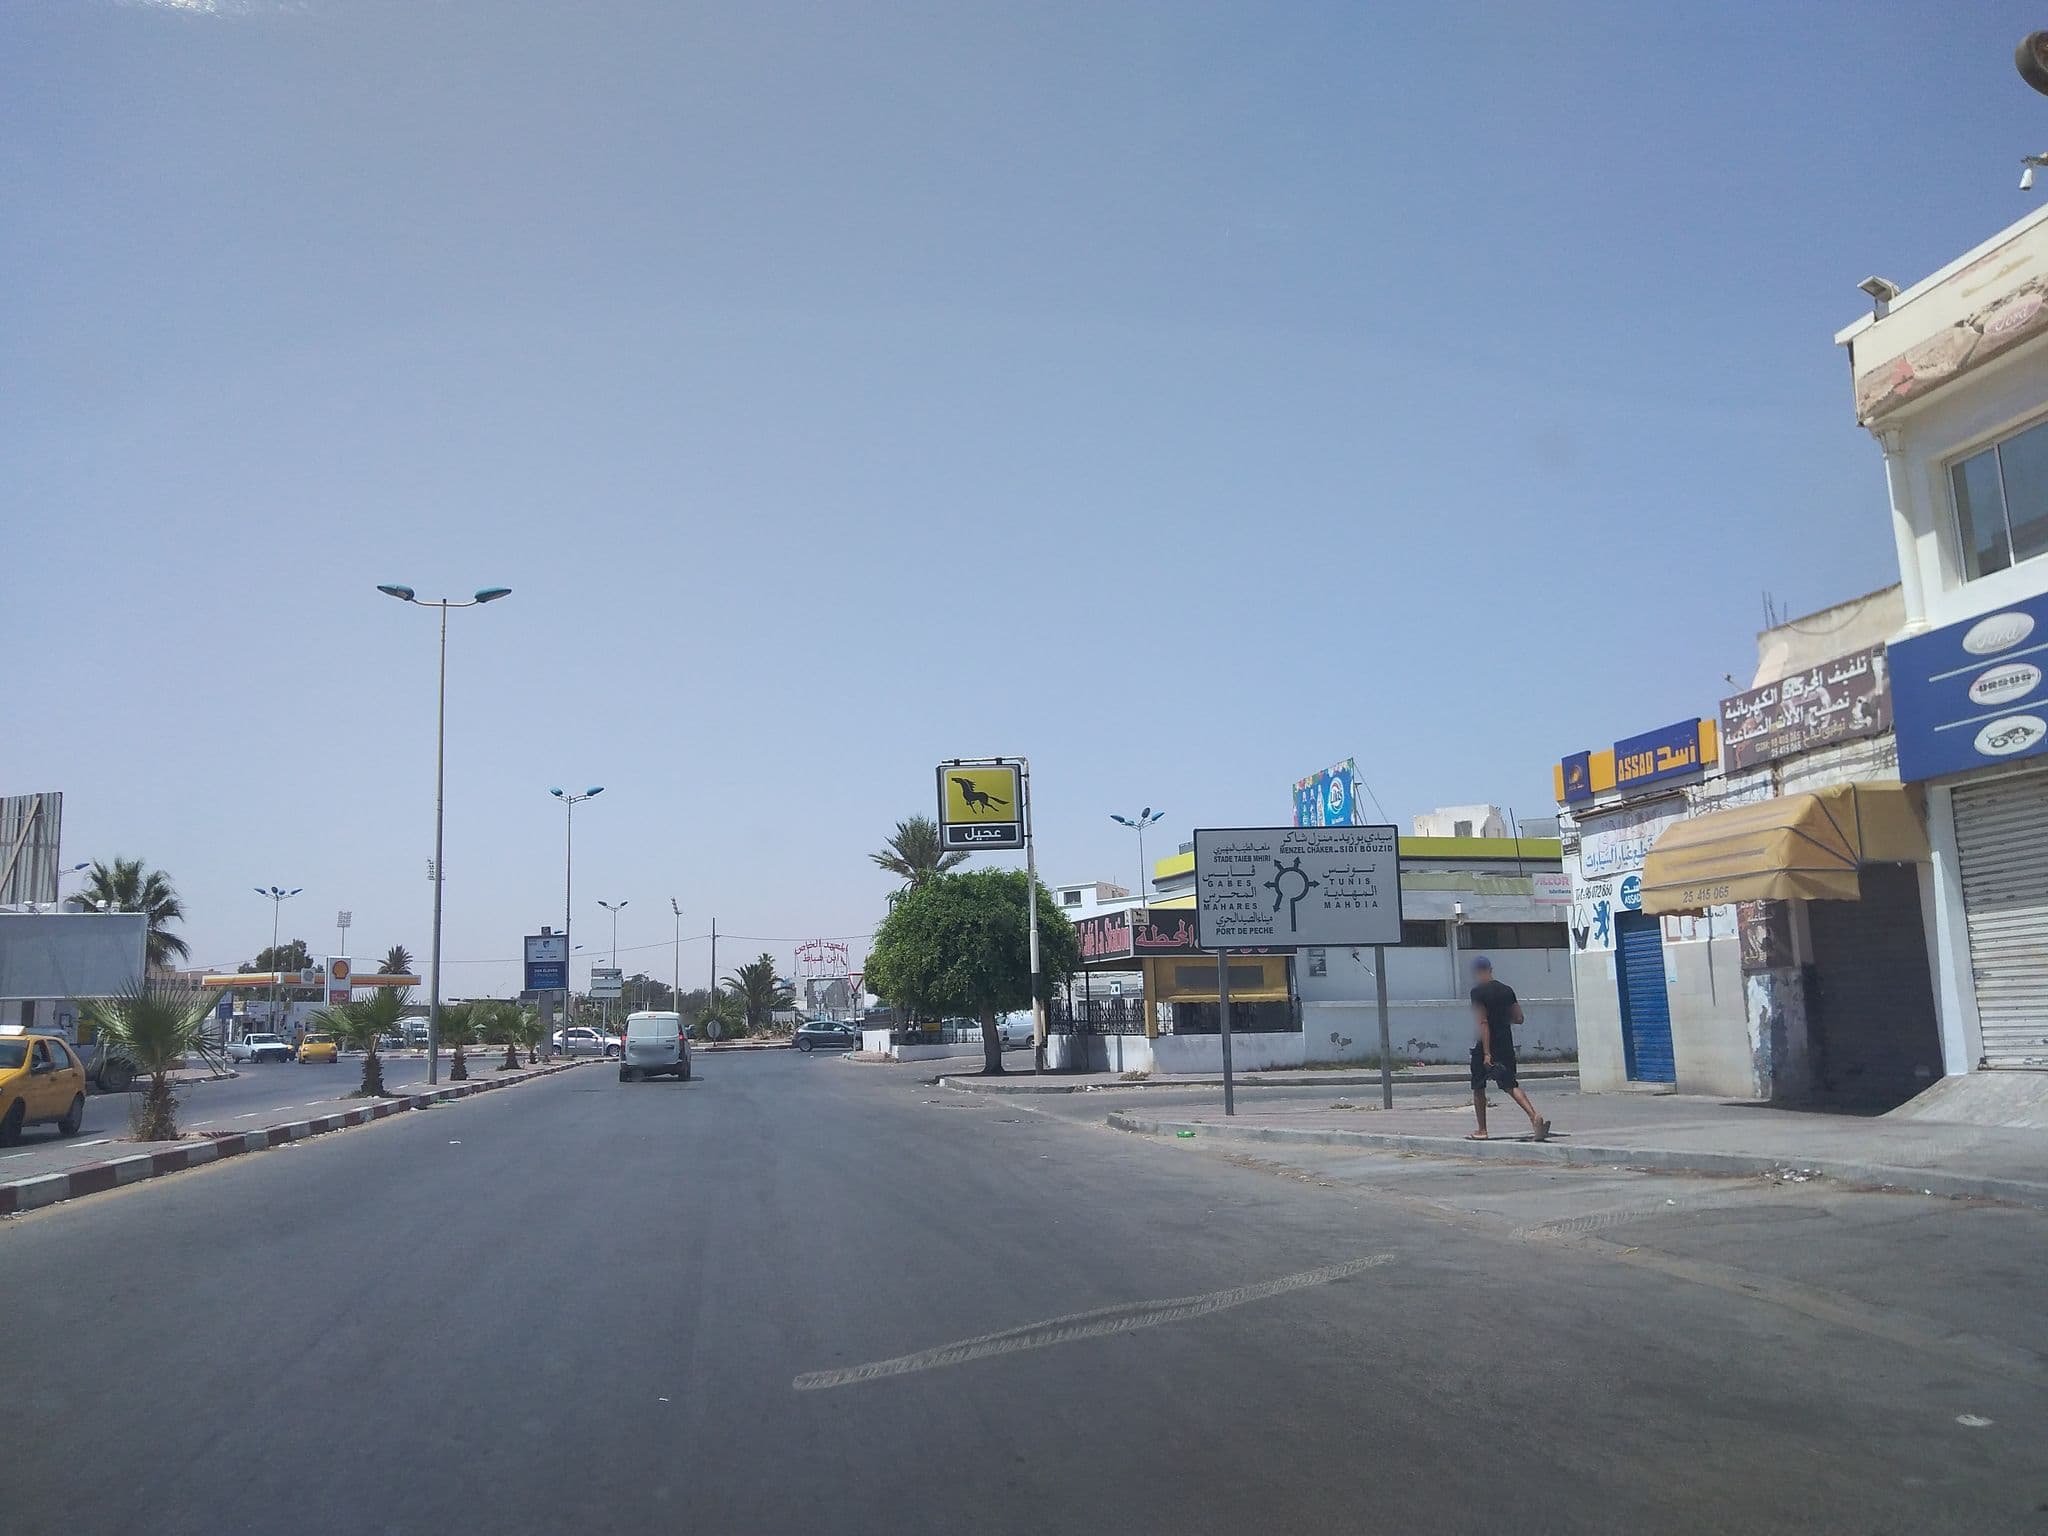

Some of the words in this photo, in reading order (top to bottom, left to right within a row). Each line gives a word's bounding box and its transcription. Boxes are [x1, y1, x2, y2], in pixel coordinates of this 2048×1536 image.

[1656, 738, 1697, 772] أسد
[1618, 751, 1654, 782] ASSAD
[1280, 831, 1308, 847] شاكر
[1308, 831, 1333, 845] منزل
[1280, 846, 1305, 854] MENZEL
[1307, 846, 1333, 854] CHAKER
[1340, 845, 1357, 853] SIDI
[1360, 844, 1393, 853] BOUZID
[1213, 855, 1233, 863] STADE
[1234, 855, 1252, 863] TAIEB
[1253, 854, 1271, 862] MHIRI
[1322, 864, 1376, 878] تونس
[1329, 878, 1371, 886] TUNIS
[1203, 886, 1256, 903] المحرس
[1323, 885, 1377, 900] المهدية
[1682, 891, 1693, 904] 25
[1697, 888, 1711, 901] 415
[1713, 886, 1729, 899] 065
[1105, 916, 1130, 954] Station
[1135, 918, 1194, 948] المحطة
[1216, 927, 1235, 935] PORT
[1249, 926, 1274, 935] PECHE
